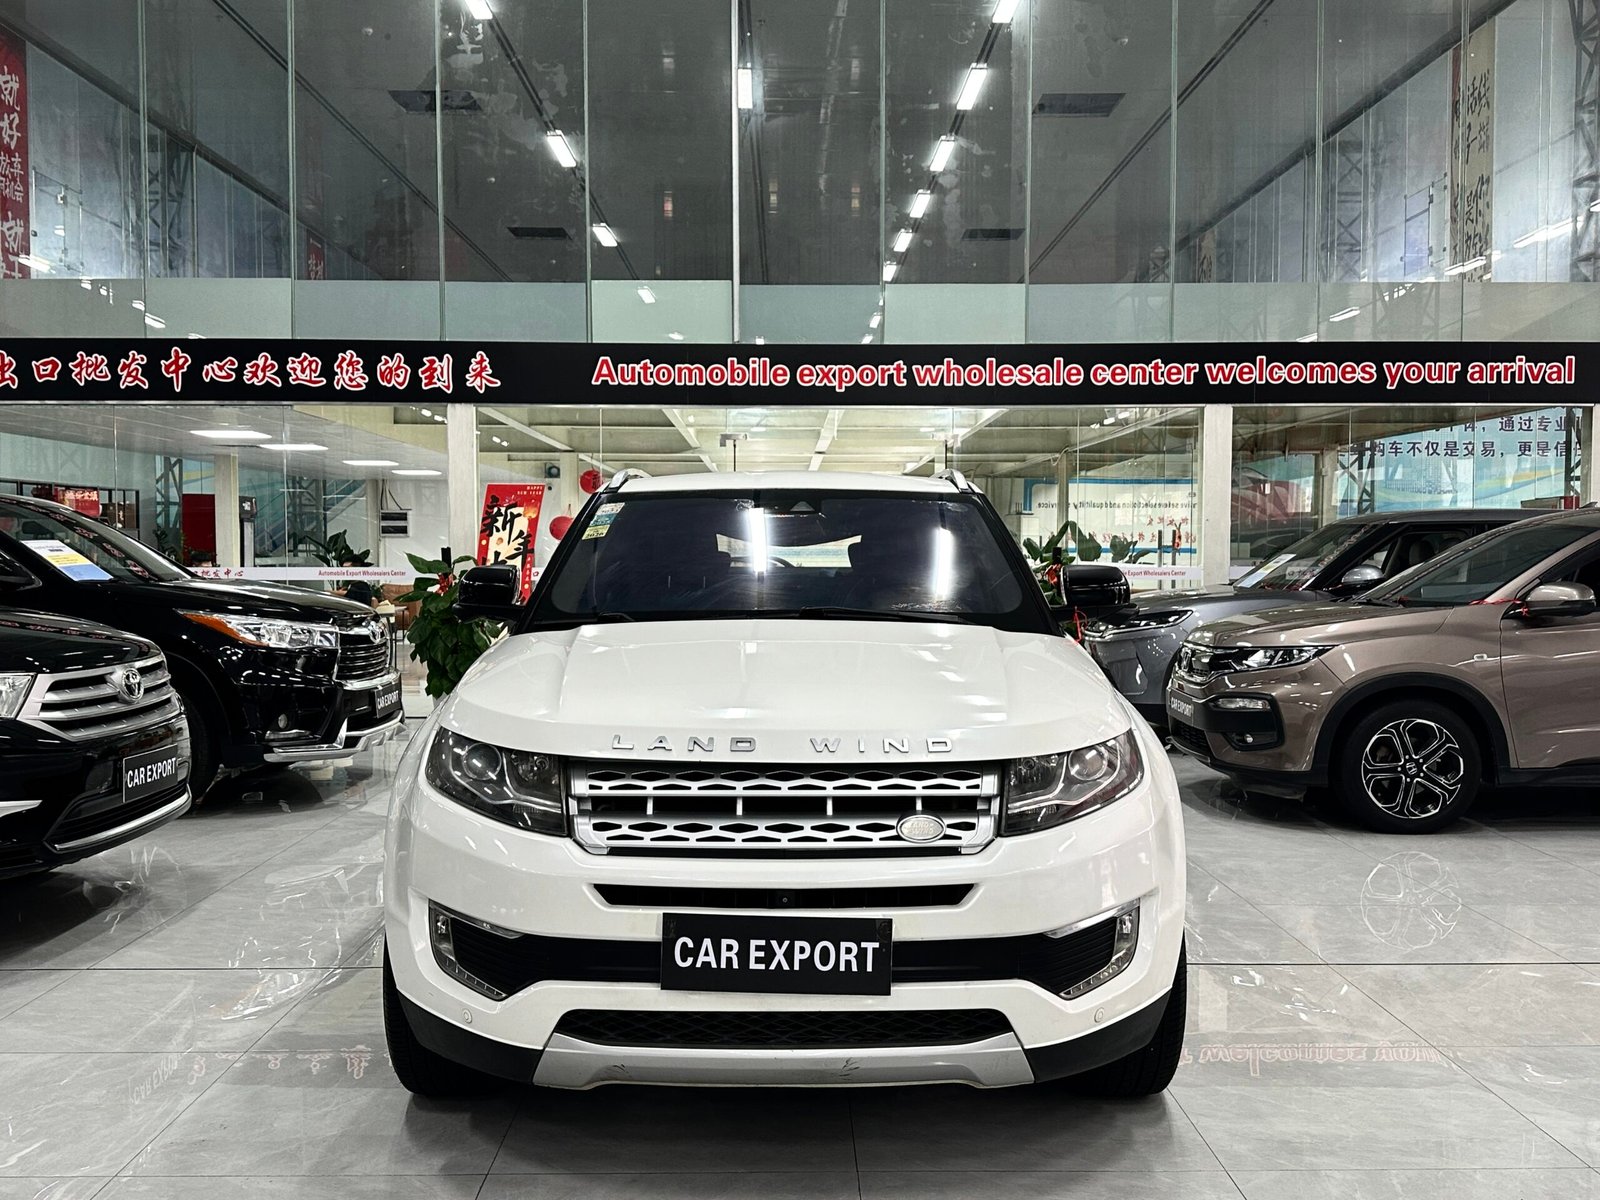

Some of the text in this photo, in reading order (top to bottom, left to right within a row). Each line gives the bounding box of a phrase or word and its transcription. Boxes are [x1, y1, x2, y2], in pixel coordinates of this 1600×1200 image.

[592, 355, 1576, 392] Automobile export wholesale center welcomes your arrival
[318, 569, 345, 577] Automobile
[346, 570, 361, 578] Export
[391, 569, 406, 577] Center
[1127, 569, 1143, 578] Export
[1170, 569, 1186, 577] Center
[612, 734, 953, 753] LAND WIND
[127, 757, 176, 788] CAR EXPORT
[674, 936, 880, 972] CAR EXPORT
